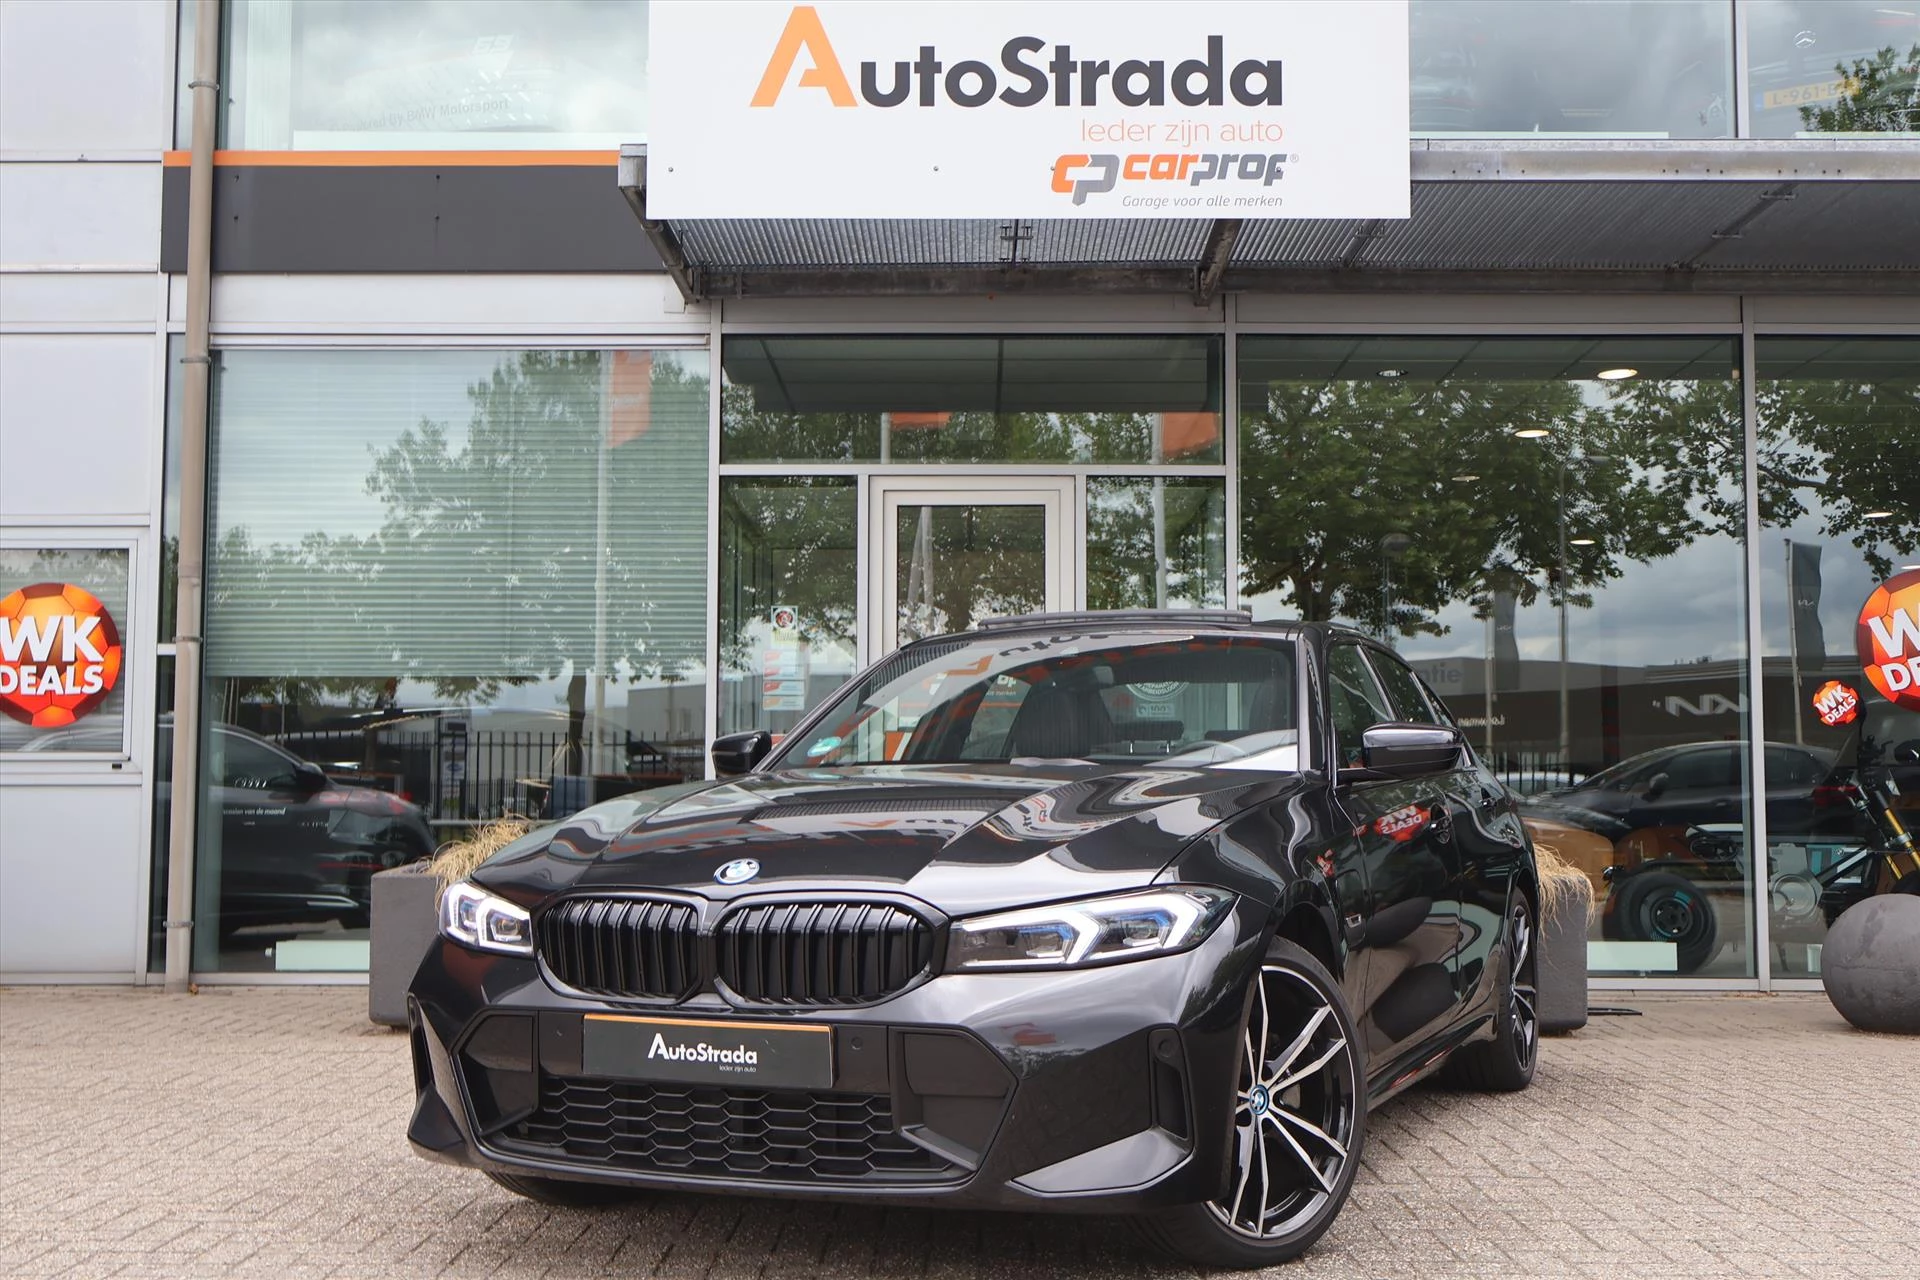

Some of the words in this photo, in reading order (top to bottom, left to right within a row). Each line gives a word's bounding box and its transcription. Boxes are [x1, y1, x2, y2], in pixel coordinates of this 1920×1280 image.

[749, 5, 1284, 108] AutoStrada
[407, 105, 436, 121] BMW
[1081, 118, 1156, 142] Ieder
[1165, 119, 1211, 148] zijn
[1220, 122, 1284, 142] auto
[1122, 153, 1288, 187] carprof
[1122, 195, 1169, 210] Garage
[1173, 197, 1202, 207] voor
[1206, 194, 1230, 208] alle
[1234, 195, 1283, 208] merken
[0, 616, 104, 662] WK
[1867, 602, 1920, 659] W
[0, 665, 104, 696] DEALS
[1815, 684, 1851, 714] WK
[1825, 695, 1857, 723] DEALS
[648, 1032, 758, 1065] AutoStrada
